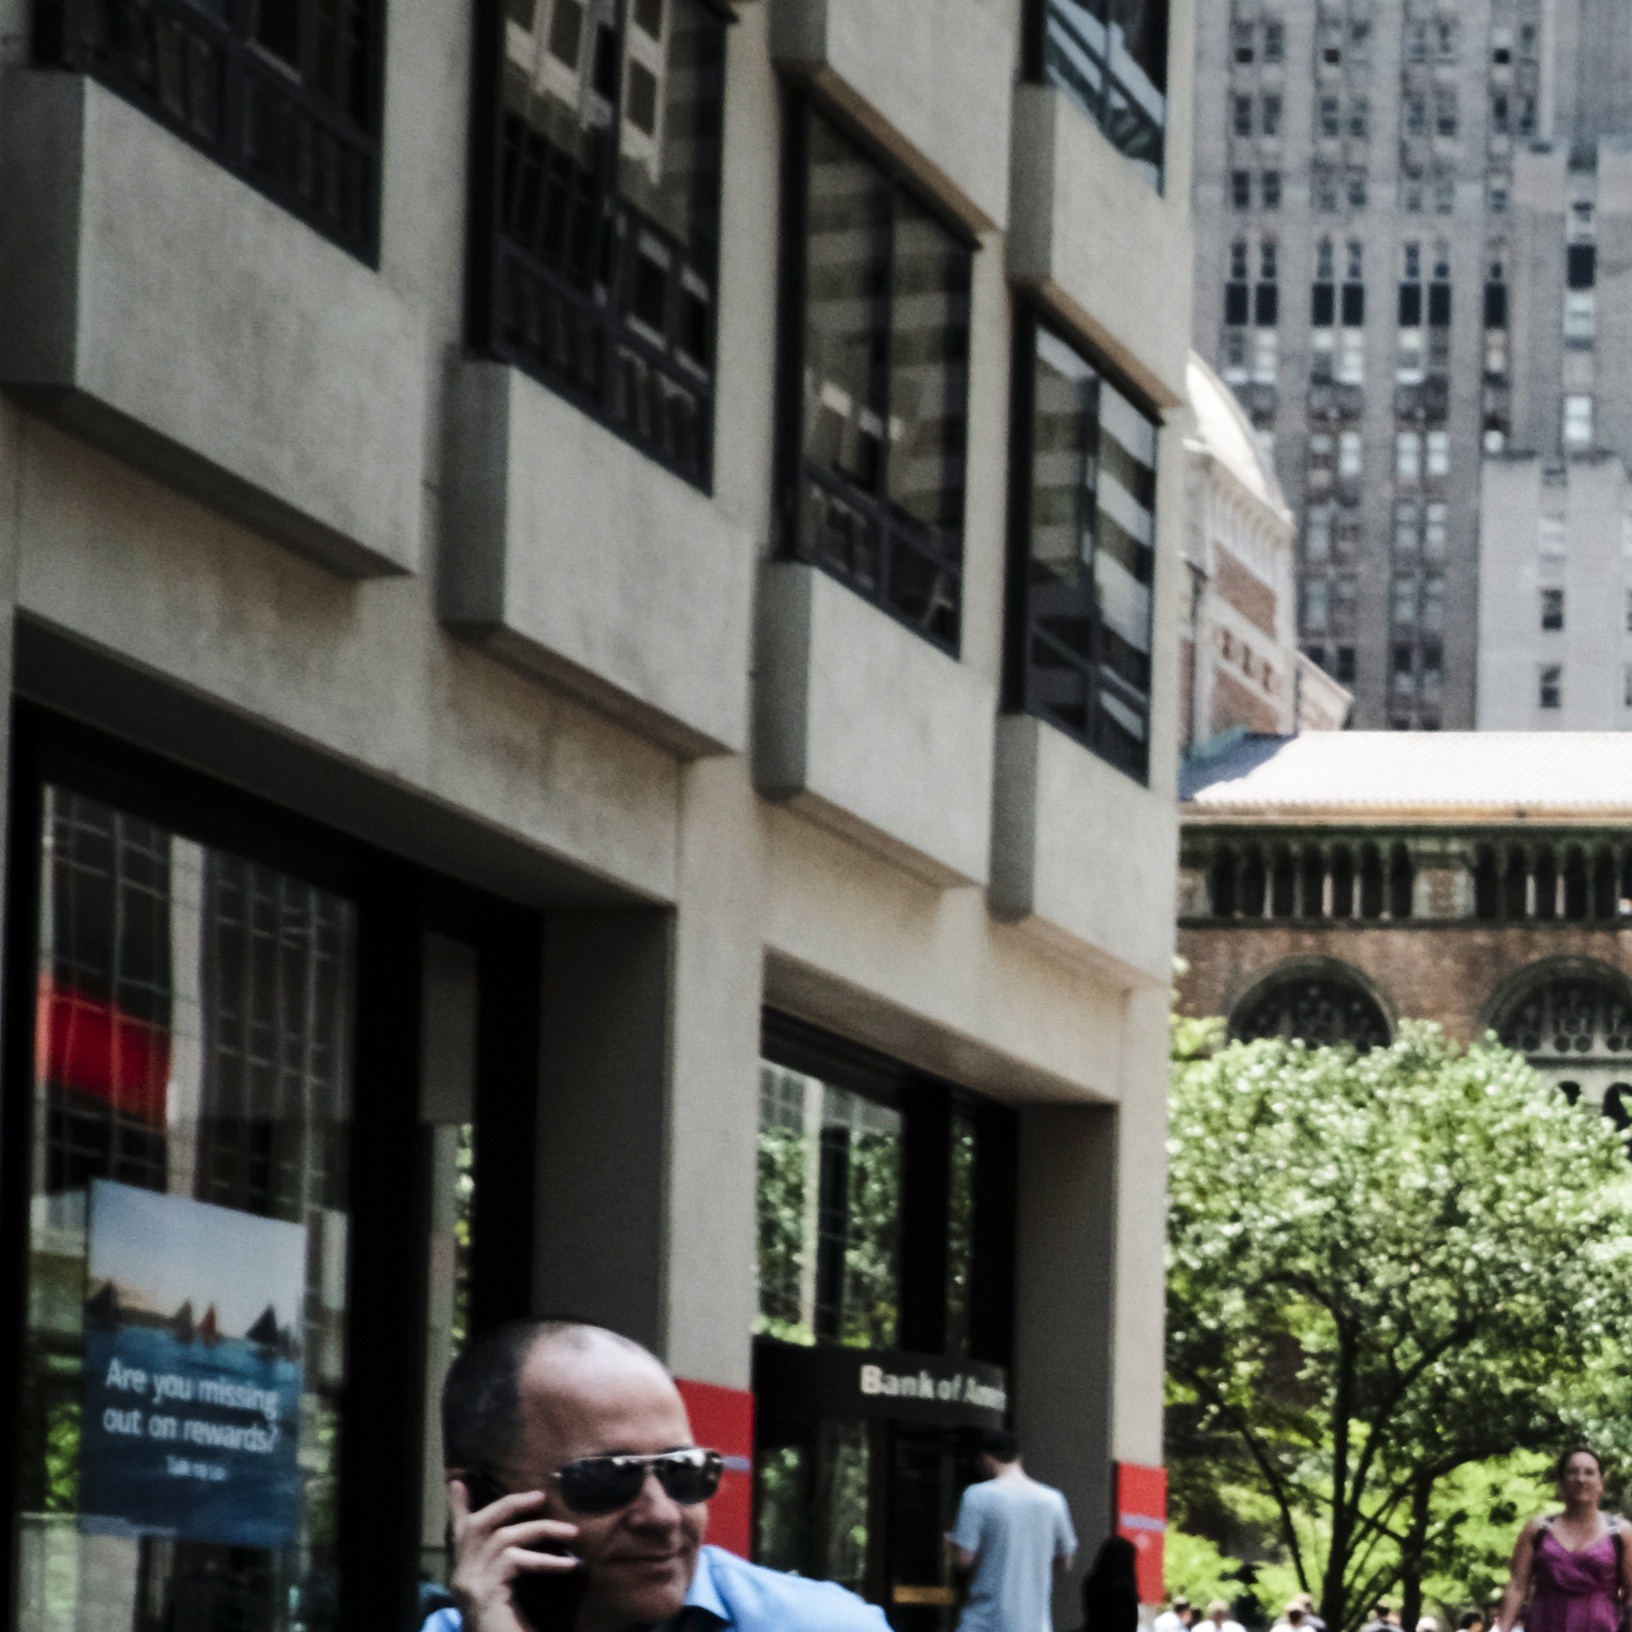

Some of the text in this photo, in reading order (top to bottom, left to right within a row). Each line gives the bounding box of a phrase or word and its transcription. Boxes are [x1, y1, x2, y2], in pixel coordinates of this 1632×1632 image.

[105, 1356, 279, 1422] Are you missing
[860, 1364, 934, 1399] Bank
[937, 1373, 962, 1401] of
[103, 1407, 281, 1454] out on rewards?
